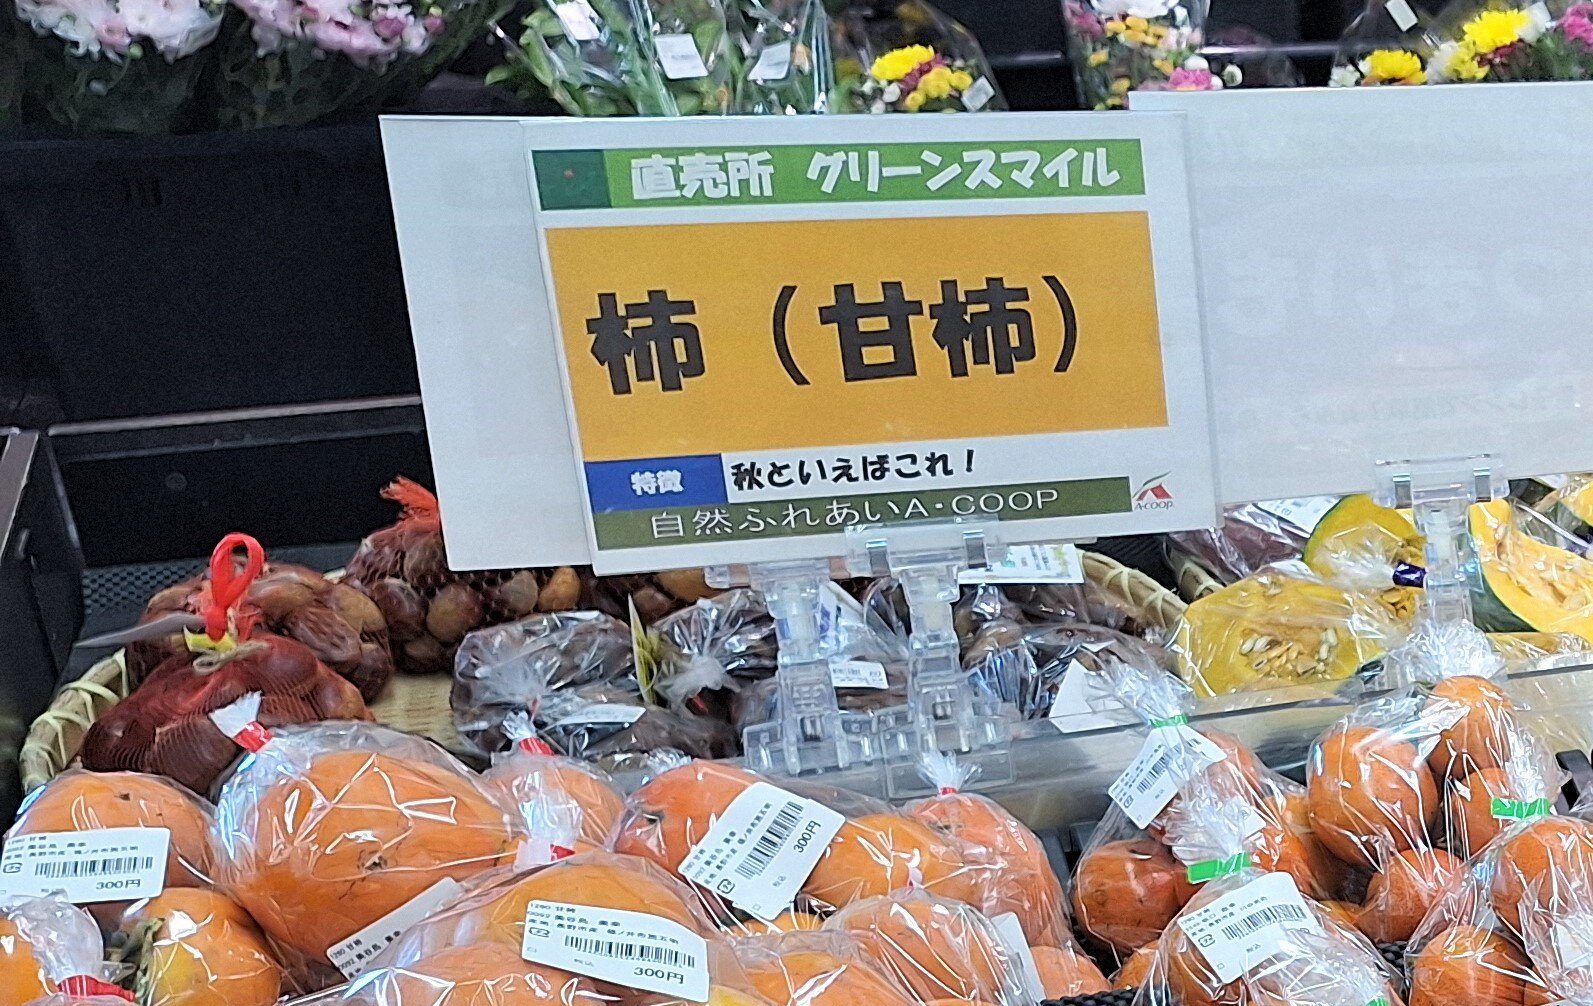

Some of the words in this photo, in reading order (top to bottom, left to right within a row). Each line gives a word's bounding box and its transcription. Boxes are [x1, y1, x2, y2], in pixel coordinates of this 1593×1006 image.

[630, 151, 774, 200] 直売所
[806, 147, 1121, 194] グリーンスマイル
[585, 276, 1078, 396] 柿（甘柿）
[630, 469, 685, 495] 特徴
[730, 448, 975, 491] 秋といえばこれ！
[651, 489, 1059, 539] 自然ふれあいA・COOP
[794, 820, 821, 853] 300円
[96, 879, 141, 889] 300円
[634, 967, 684, 984] 300円
